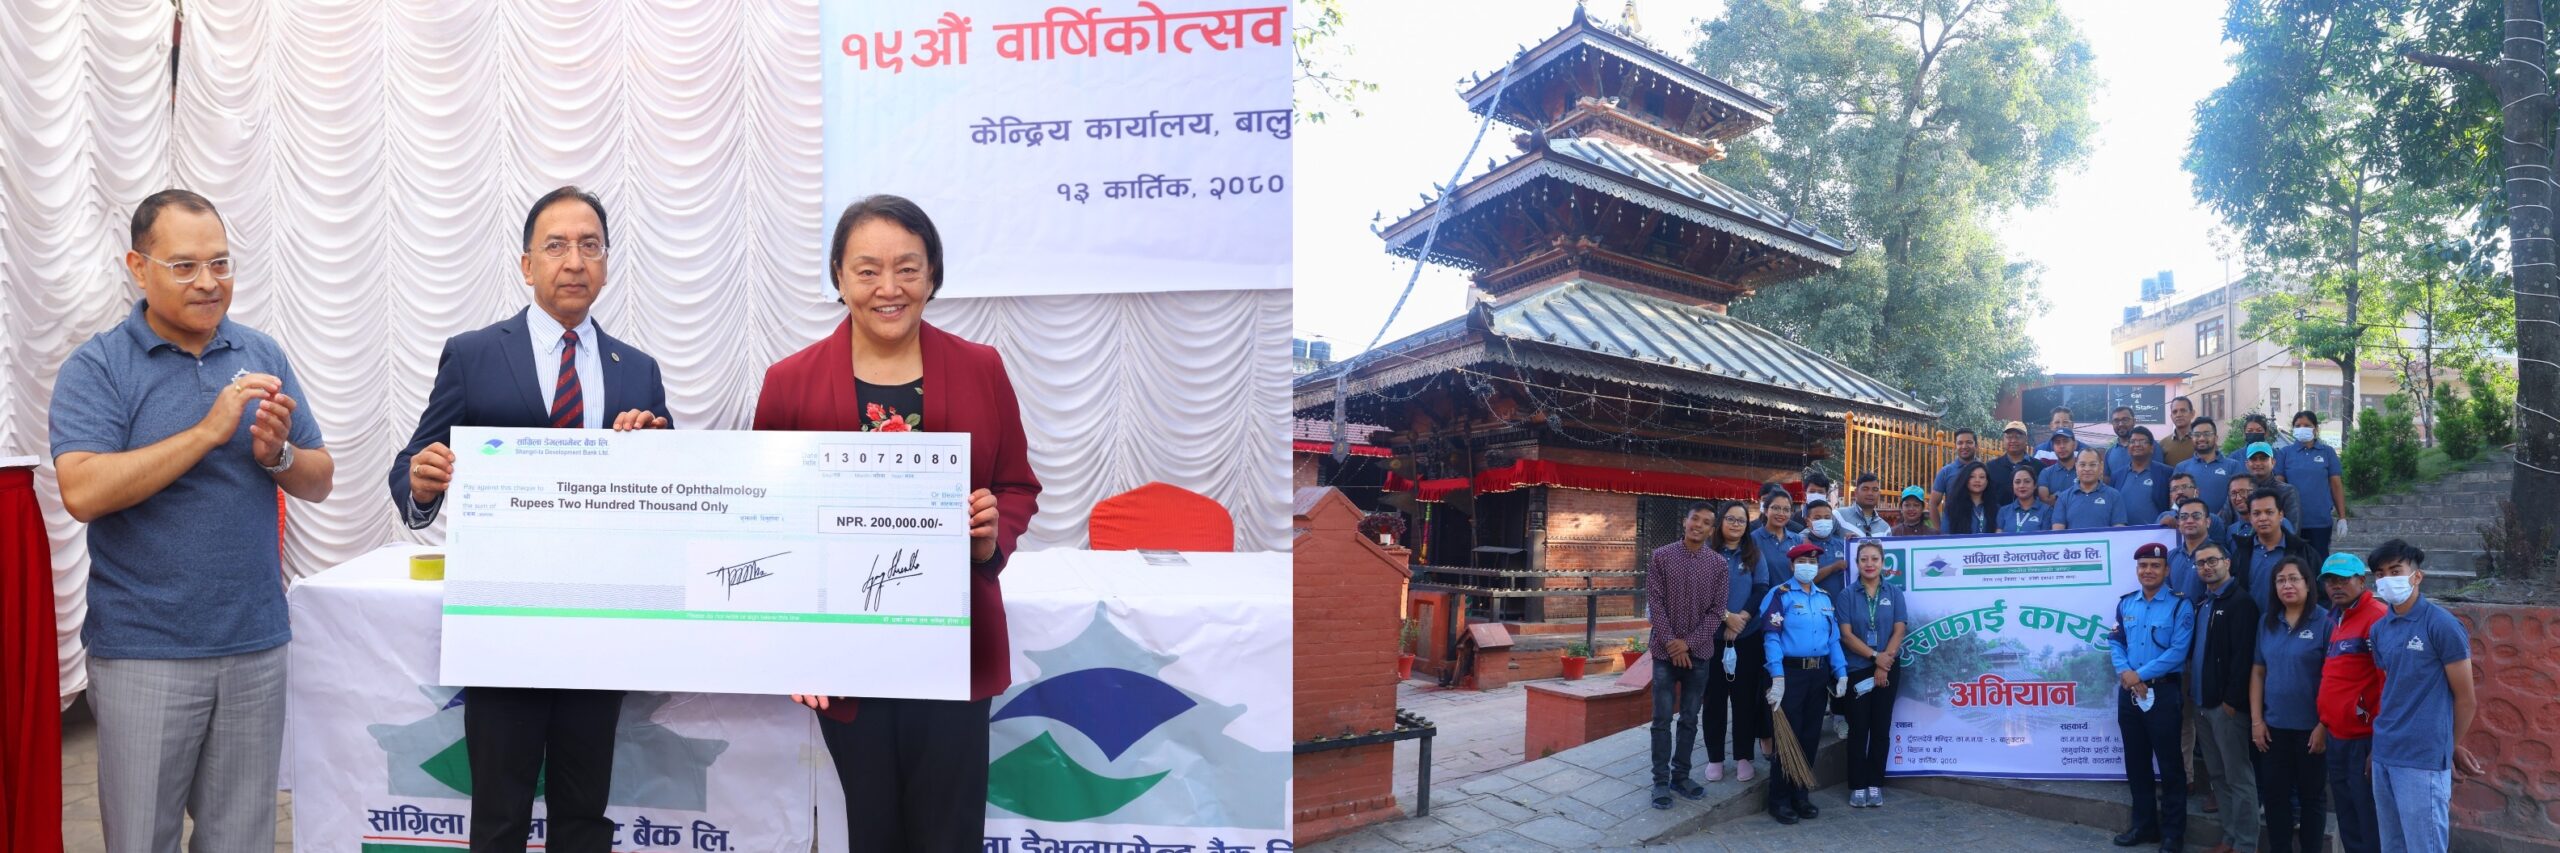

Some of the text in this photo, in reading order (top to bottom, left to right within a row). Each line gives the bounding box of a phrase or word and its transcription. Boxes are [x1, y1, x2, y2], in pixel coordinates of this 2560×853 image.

[993, 1, 1287, 63] वार्षिकोत्सव
[970, 116, 1072, 148] केन्द्रिय
[1085, 110, 1219, 141] कार्यालय,
[1056, 174, 1285, 203] १३ कार्तिक, २०८०
[510, 497, 729, 514] Rupees Two Hundred Thousand Only
[556, 482, 767, 499] Tilganga Institute of Ophthalmology
[836, 516, 943, 530] NPR. 200,000.00/-
[1949, 673, 2077, 708] अभियान
[368, 805, 465, 836] सांग्रिला
[633, 815, 682, 847] बैंक
[691, 820, 735, 852] लि.
